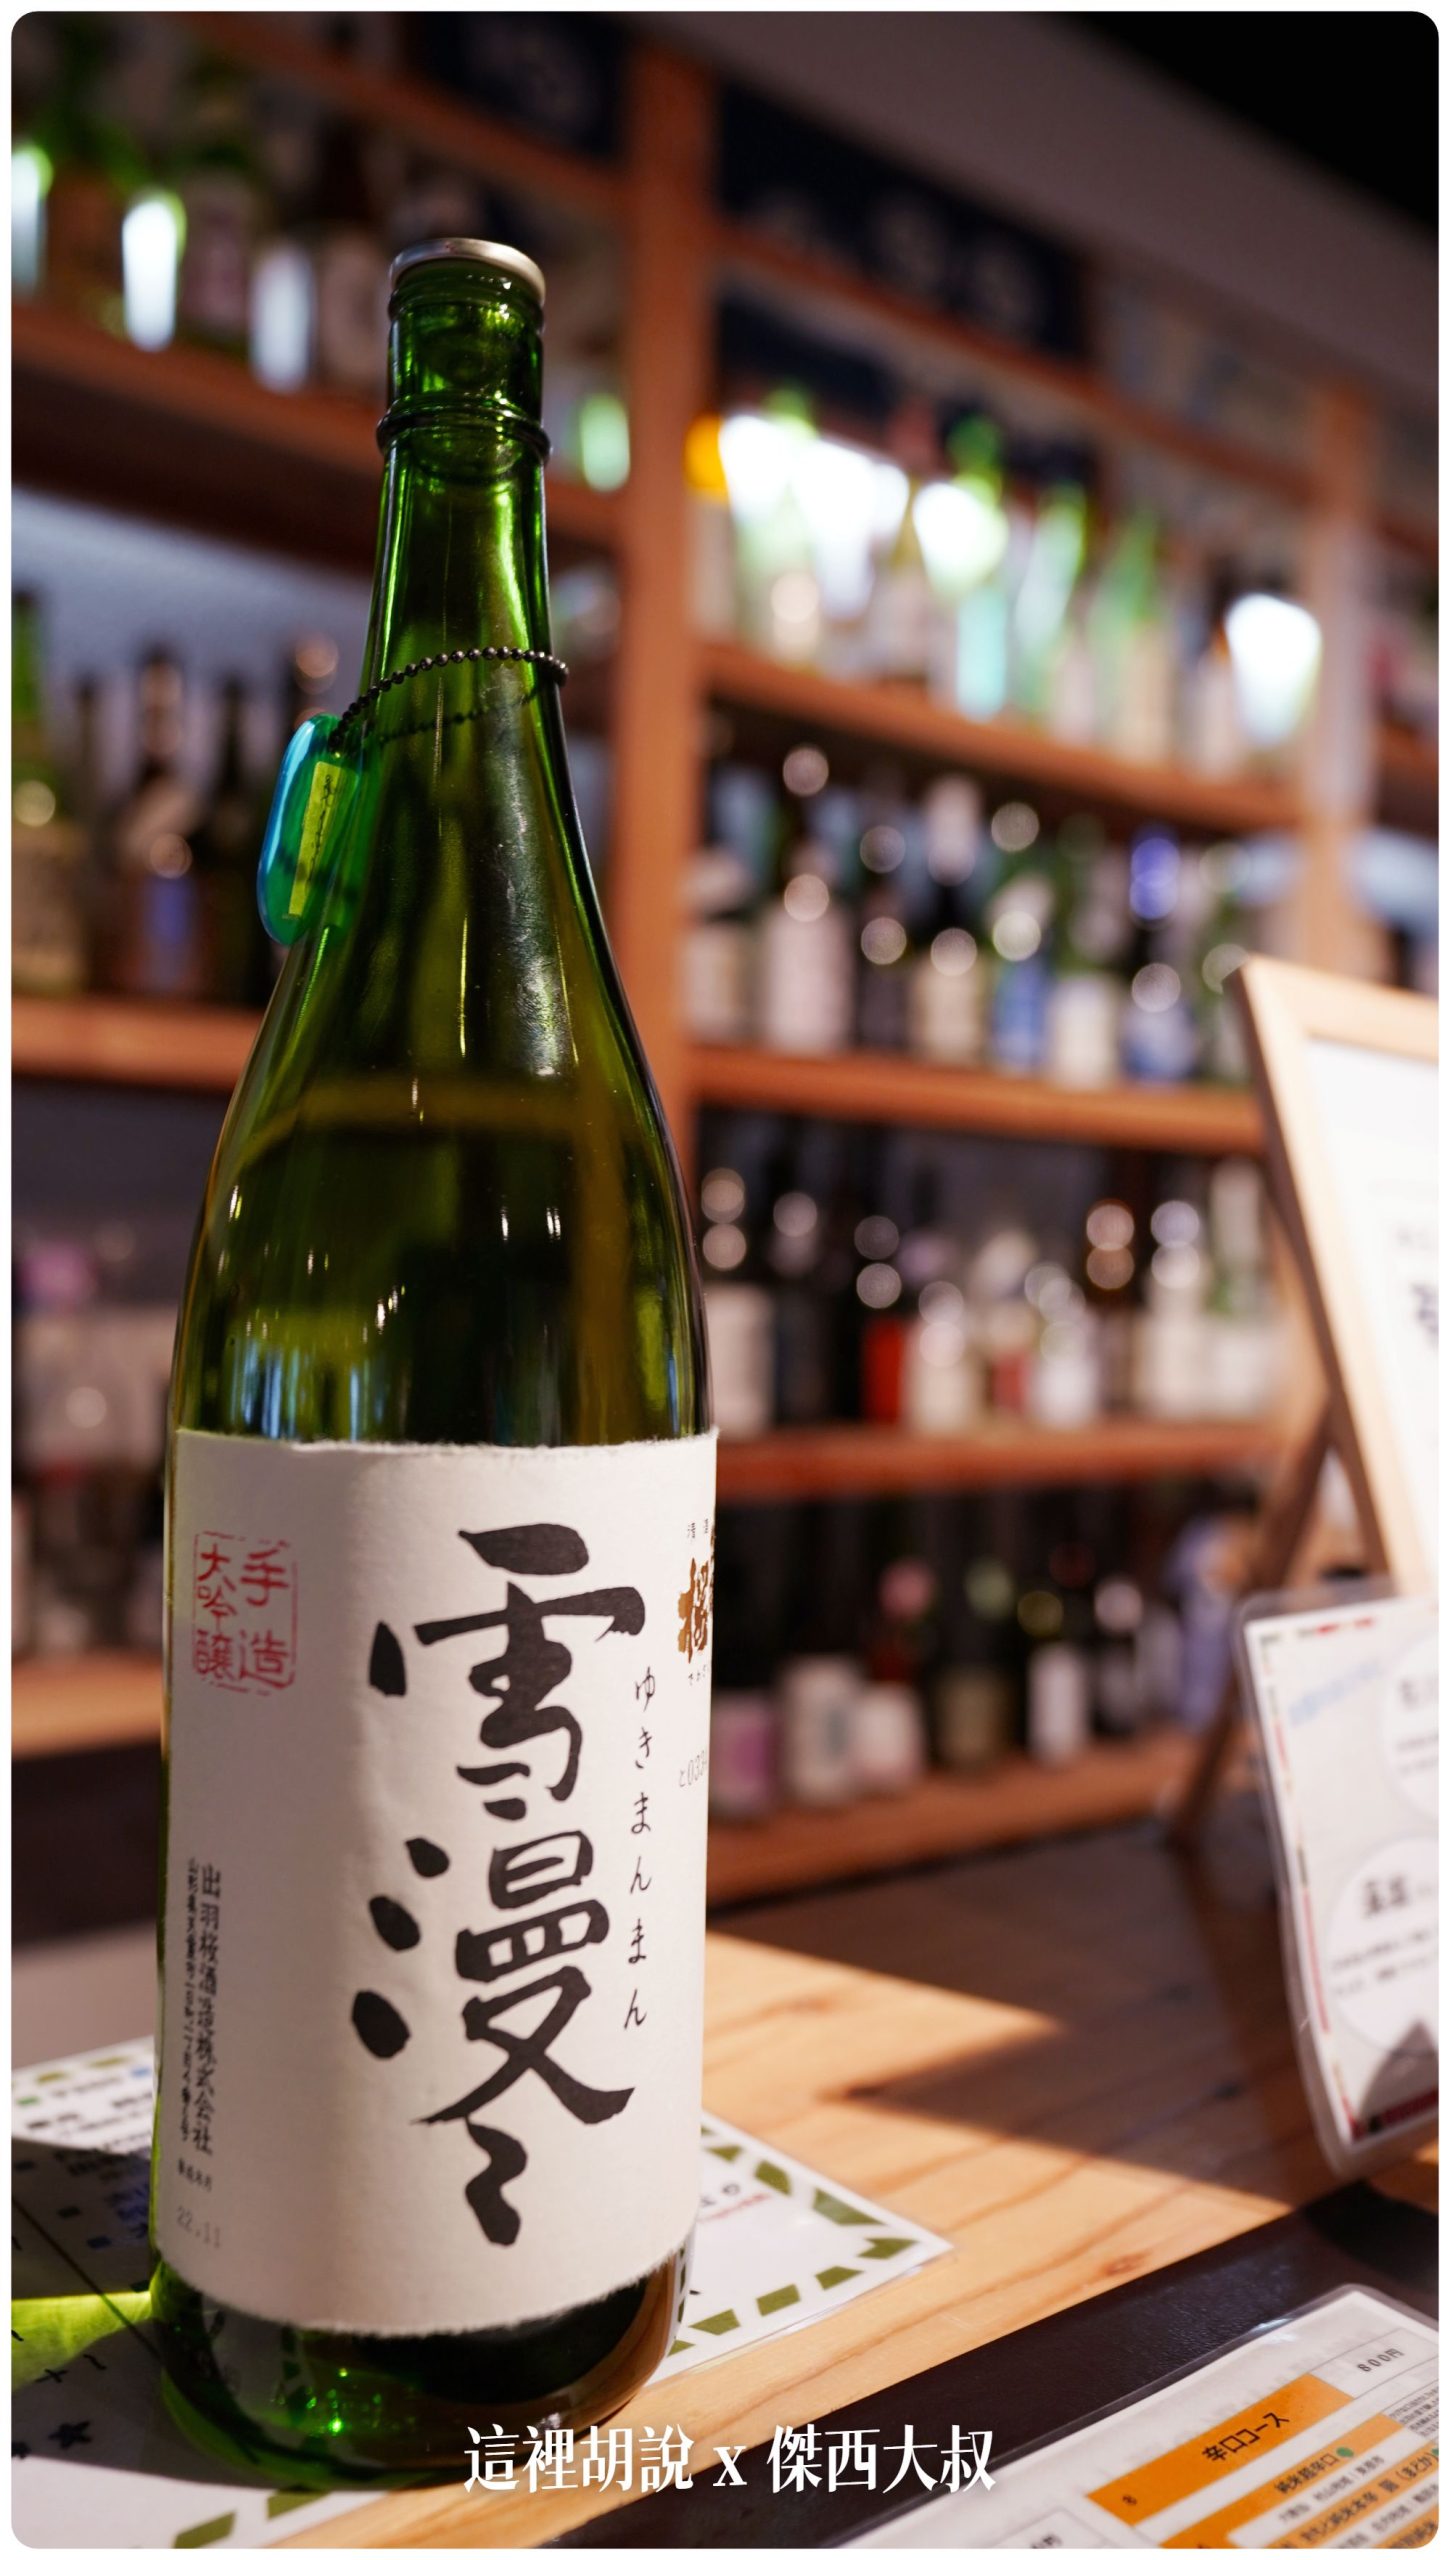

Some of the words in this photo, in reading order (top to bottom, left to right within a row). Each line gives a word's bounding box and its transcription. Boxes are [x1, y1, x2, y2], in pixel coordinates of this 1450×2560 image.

[624, 1667, 656, 2030] ゆきまんまん
[1356, 2347, 1405, 2373] 800円
[1201, 2411, 1291, 2464] 辛口コース
